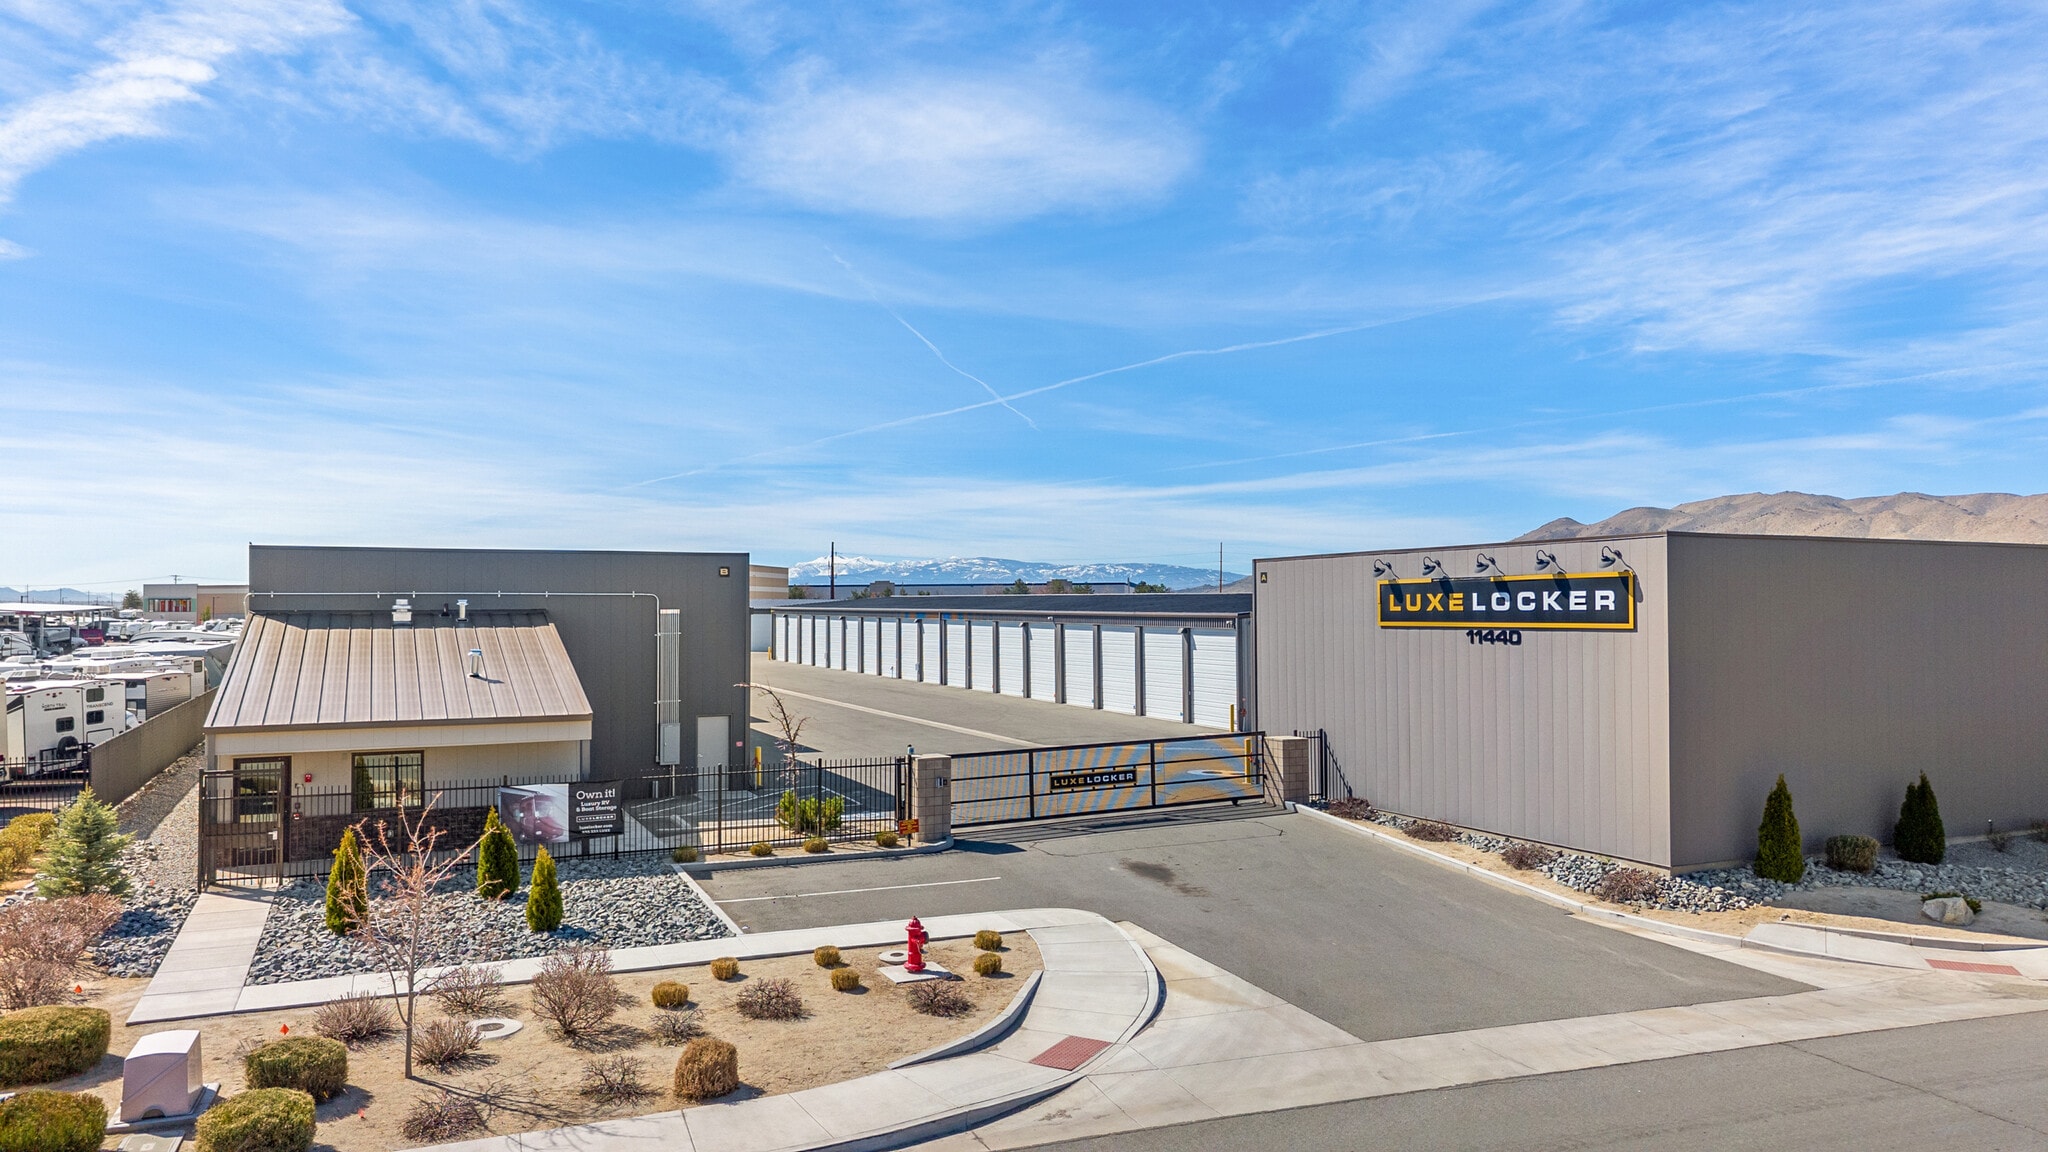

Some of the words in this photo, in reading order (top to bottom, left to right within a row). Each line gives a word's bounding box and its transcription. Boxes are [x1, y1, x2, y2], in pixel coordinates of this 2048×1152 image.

[1466, 629, 1522, 646] 11440
[576, 790, 603, 800] Own
[604, 788, 616, 798] it!
